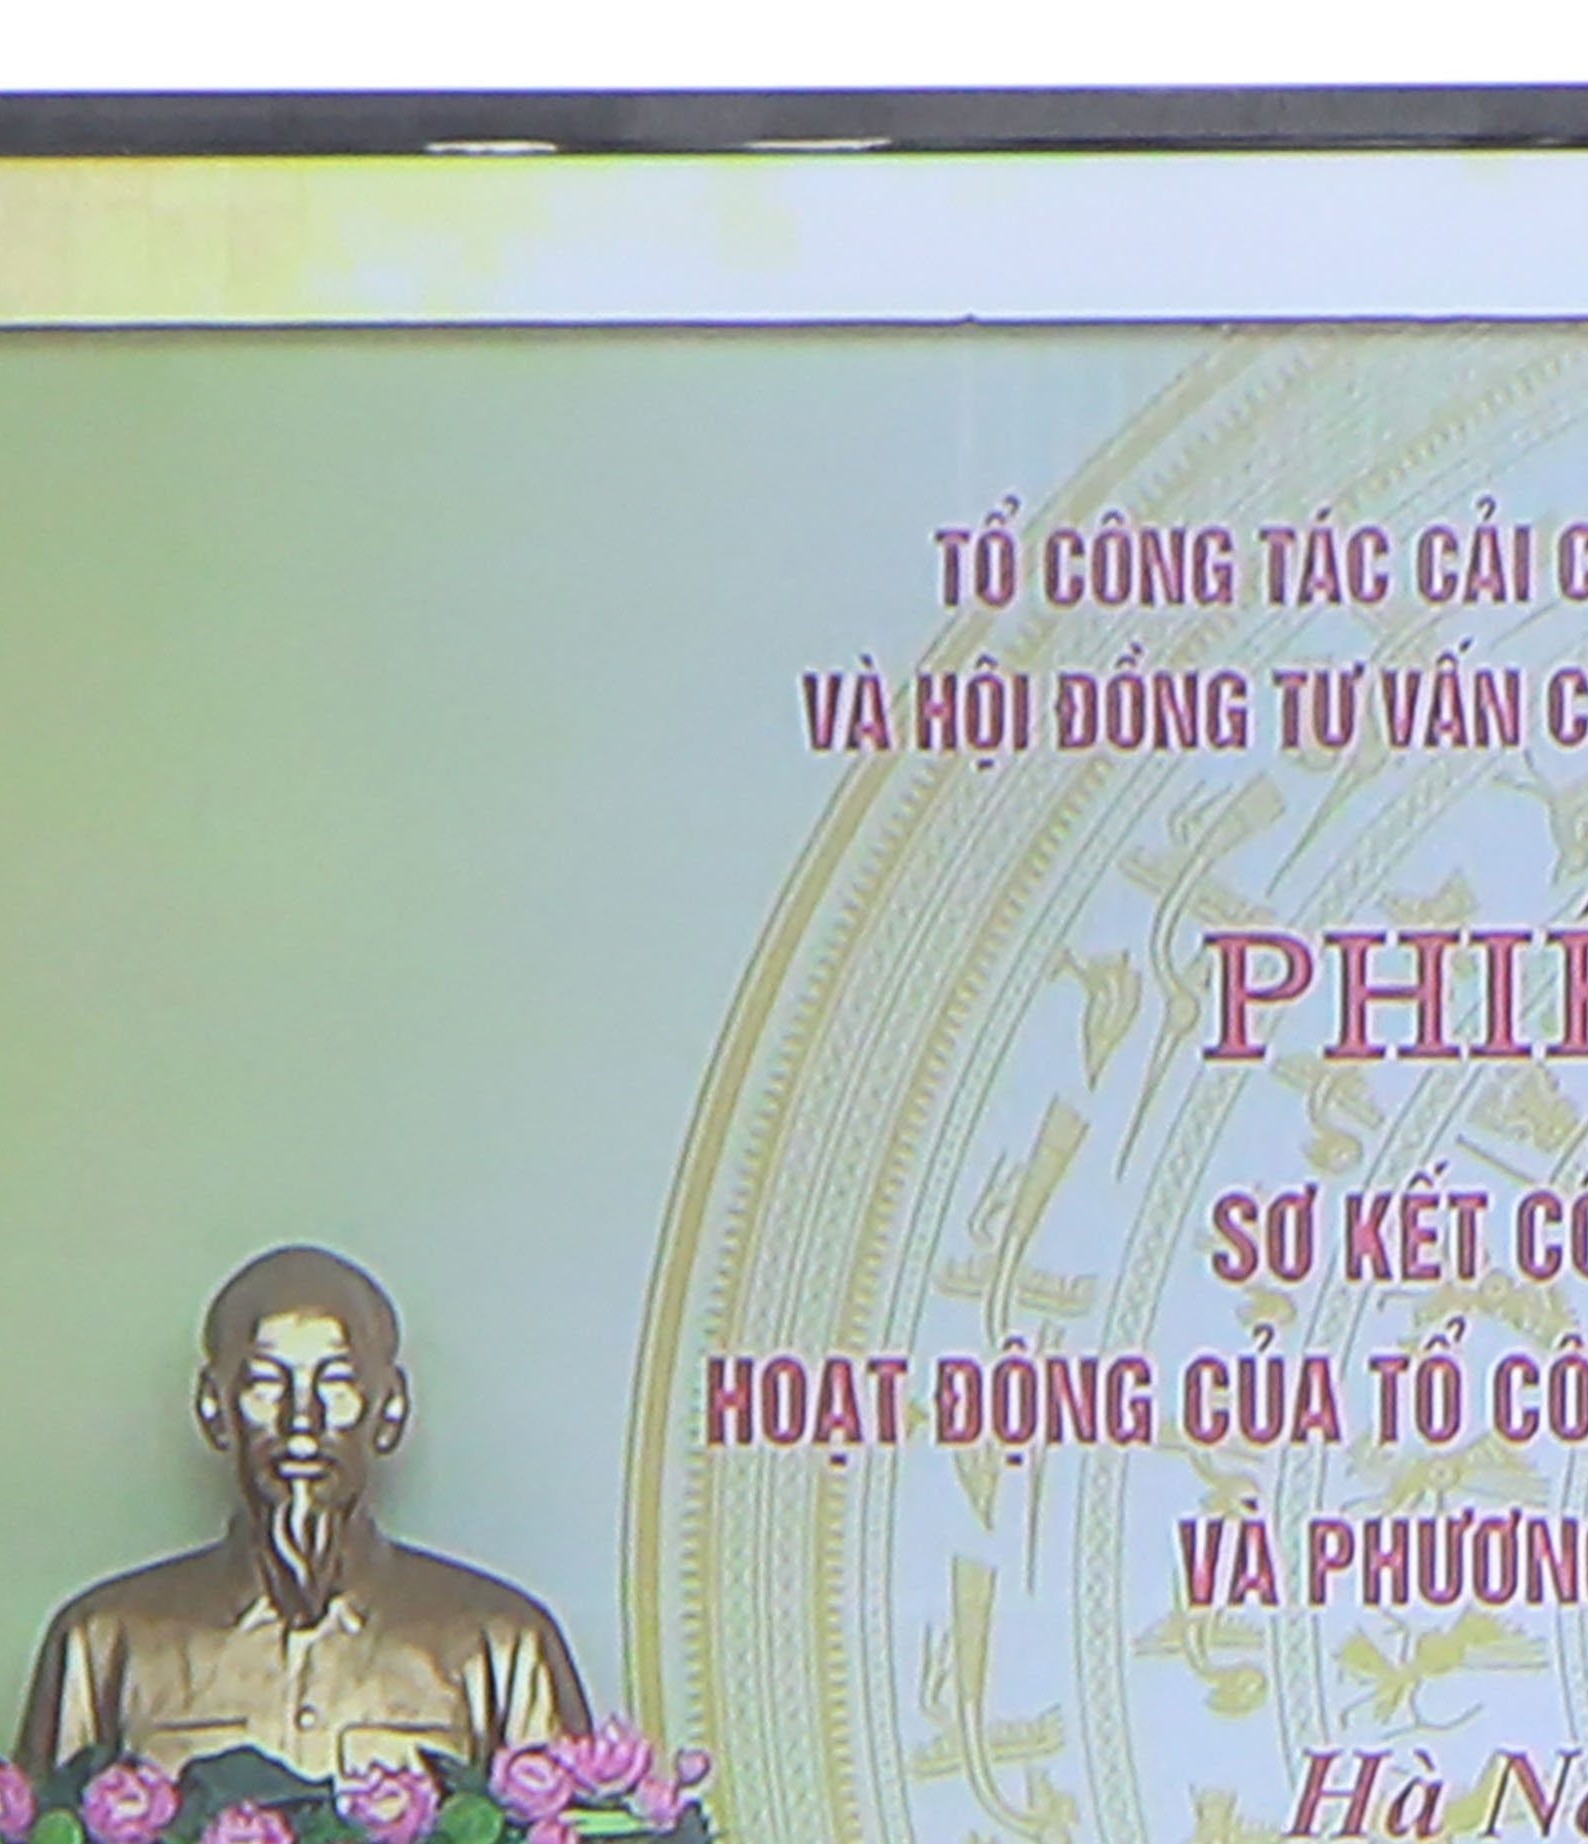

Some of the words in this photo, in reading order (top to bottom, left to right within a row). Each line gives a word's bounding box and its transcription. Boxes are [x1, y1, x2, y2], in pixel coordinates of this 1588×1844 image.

[936, 497, 1017, 604] TỔ
[1048, 510, 1232, 604] CÔNG
[1260, 508, 1387, 603] TÁC
[1418, 496, 1530, 602] CẢI
[803, 655, 889, 750] VÀ
[918, 655, 1028, 766] HỘI
[1055, 643, 1246, 749] ĐỒNG
[1273, 658, 1365, 748] TƯ
[1381, 640, 1518, 747] VẤN
[1214, 1180, 1316, 1280] SƠ
[1346, 1161, 1487, 1280] KẾT
[708, 1356, 908, 1466] HOẠT
[935, 1338, 1152, 1464] ĐỘNG
[1183, 1325, 1342, 1443] CỦA
[1369, 1317, 1464, 1441] TỔ
[1178, 1498, 1278, 1606] VÀ
[1286, 1750, 1443, 1838] Hà
